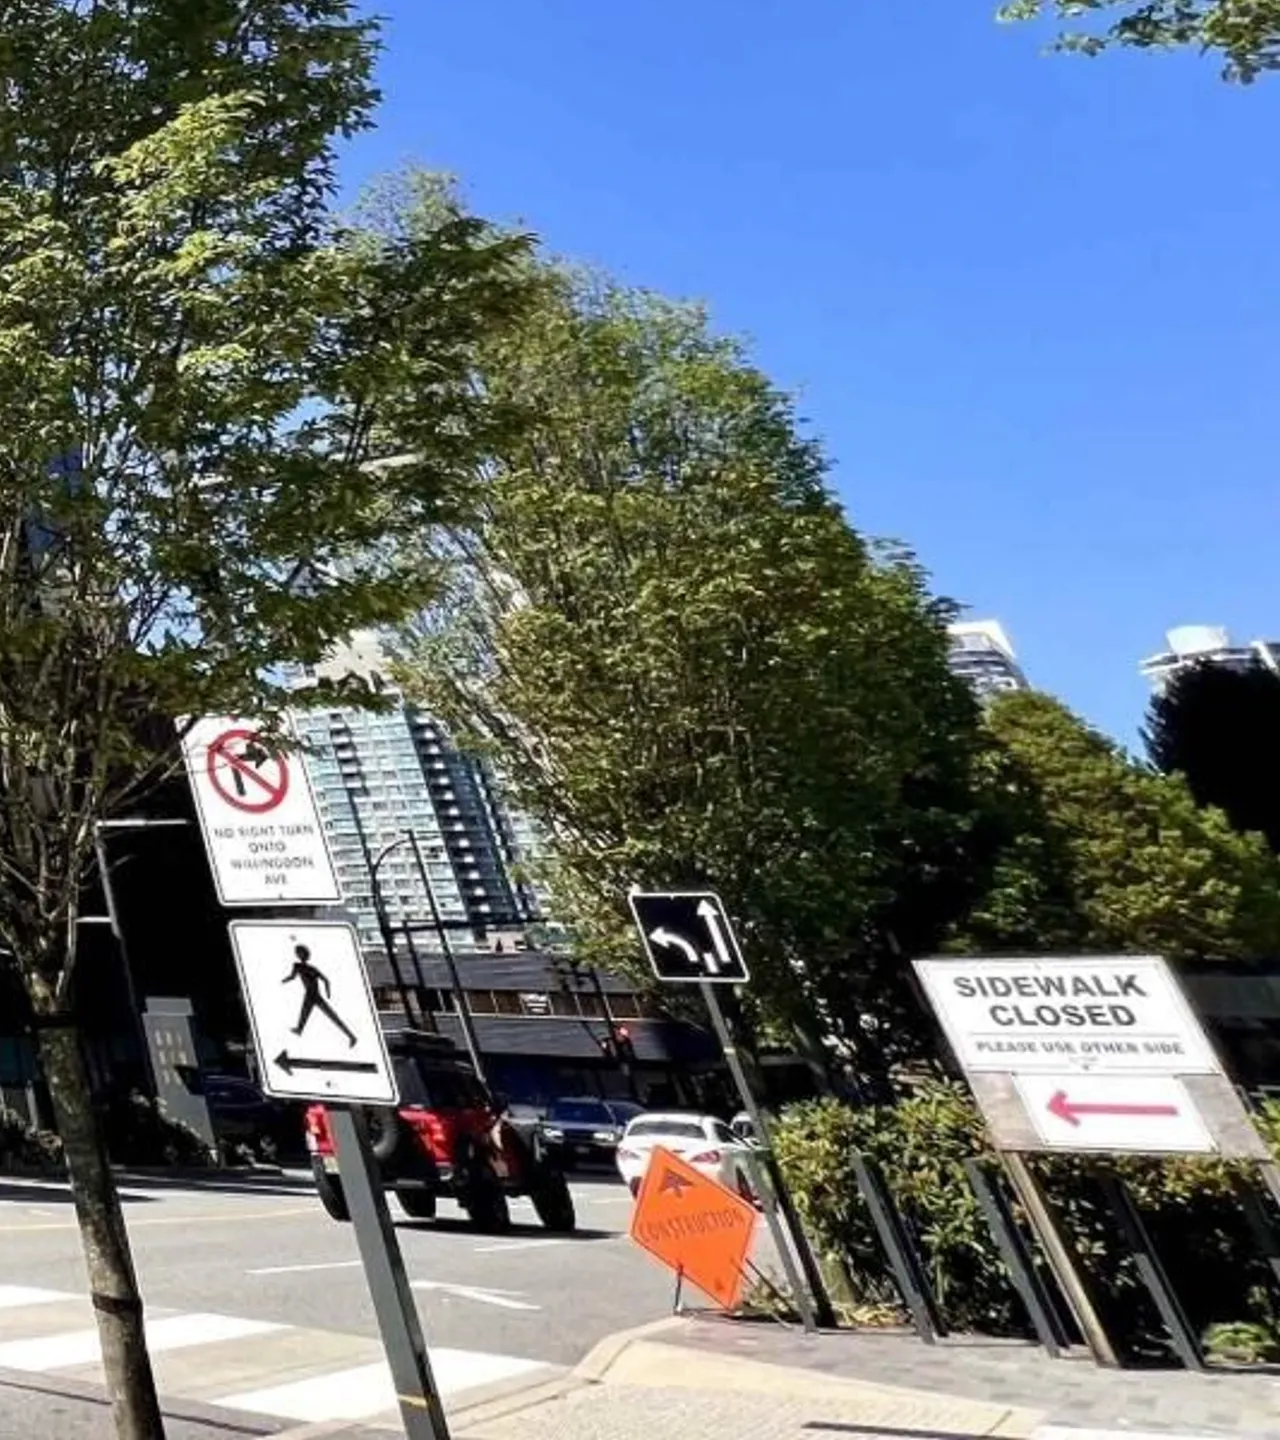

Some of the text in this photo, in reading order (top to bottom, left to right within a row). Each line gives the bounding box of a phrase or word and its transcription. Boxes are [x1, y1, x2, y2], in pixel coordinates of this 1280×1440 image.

[214, 824, 314, 838] NO RIGHT TURN
[248, 841, 287, 854] ONTO
[230, 856, 315, 870] WILLINGDON
[264, 873, 287, 885] AVE
[953, 974, 1148, 998] SIDEWALK
[989, 1005, 1137, 1027] CLOSED
[976, 1040, 1186, 1055] PLEASE USE OTHER SIDE
[639, 1208, 745, 1243] CONSTRUCTION
